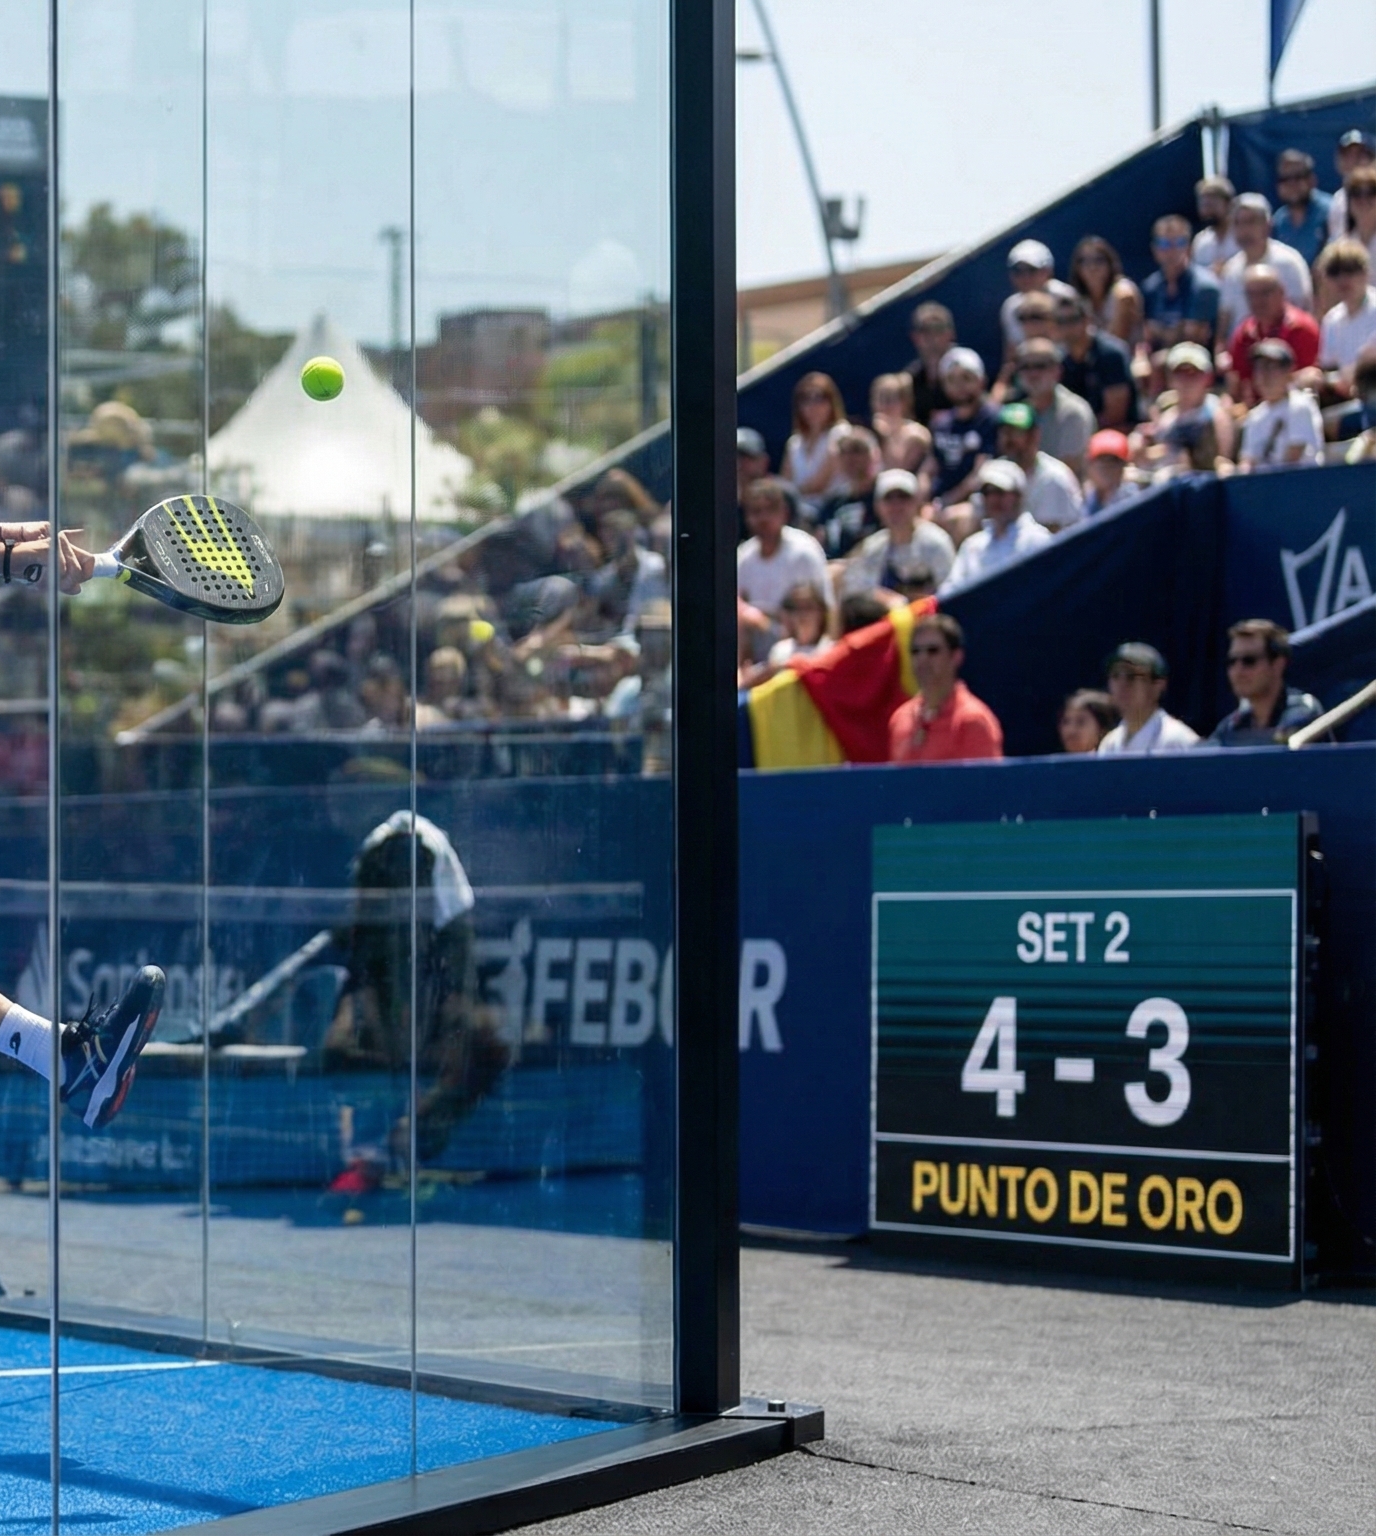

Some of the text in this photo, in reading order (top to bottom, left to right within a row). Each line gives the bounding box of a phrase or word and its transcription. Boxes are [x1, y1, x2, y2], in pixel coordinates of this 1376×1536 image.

[1016, 911, 1130, 963] SET 2
[531, 936, 788, 1052] FEBR
[961, 996, 1191, 1127] 4 - 3
[912, 1160, 1244, 1236] PUNTO DE ORO
